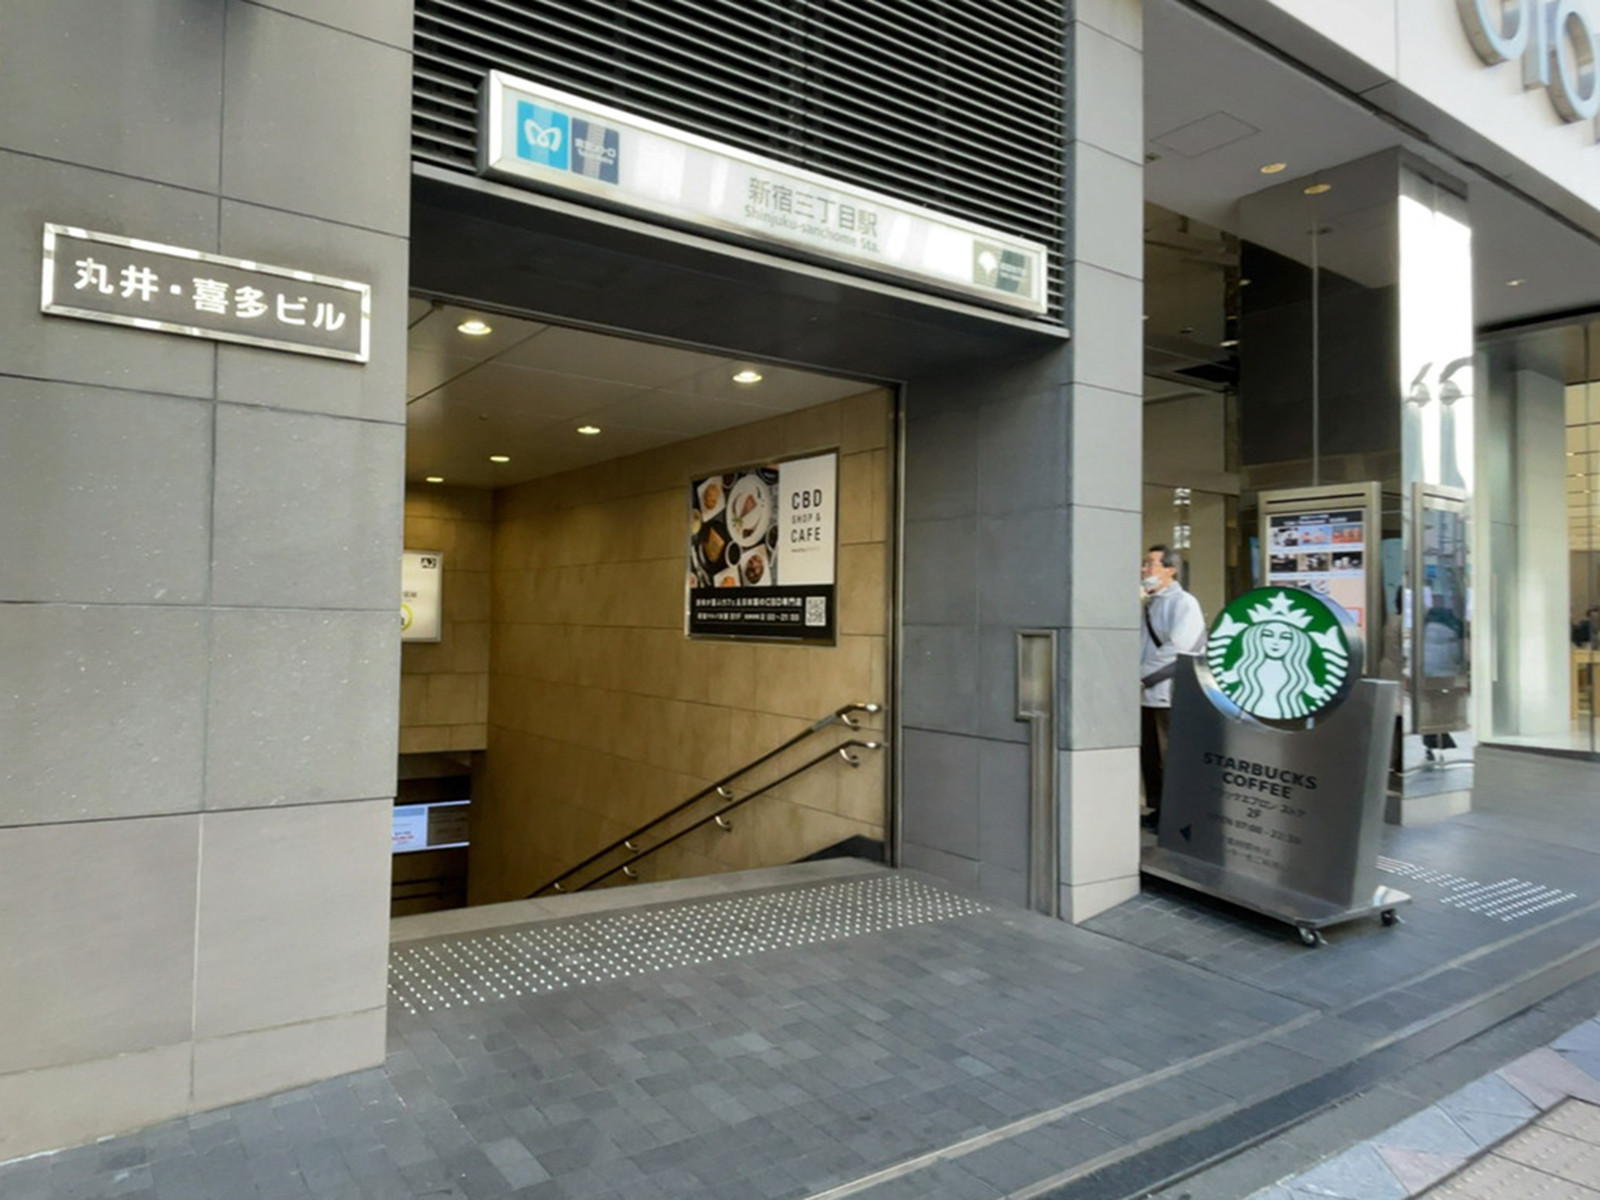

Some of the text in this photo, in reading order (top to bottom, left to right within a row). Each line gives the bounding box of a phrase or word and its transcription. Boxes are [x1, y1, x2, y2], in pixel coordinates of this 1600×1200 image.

[748, 176, 878, 238] 新宿三丁目駅
[73, 256, 347, 332] 丸井・喜多ビル
[791, 488, 823, 510] CBD
[791, 513, 813, 525] SHOP
[790, 526, 821, 543] CAFE
[1202, 751, 1318, 790] STARBUCKS
[1221, 771, 1293, 800] COFFEE
[1246, 807, 1262, 819] 2F
